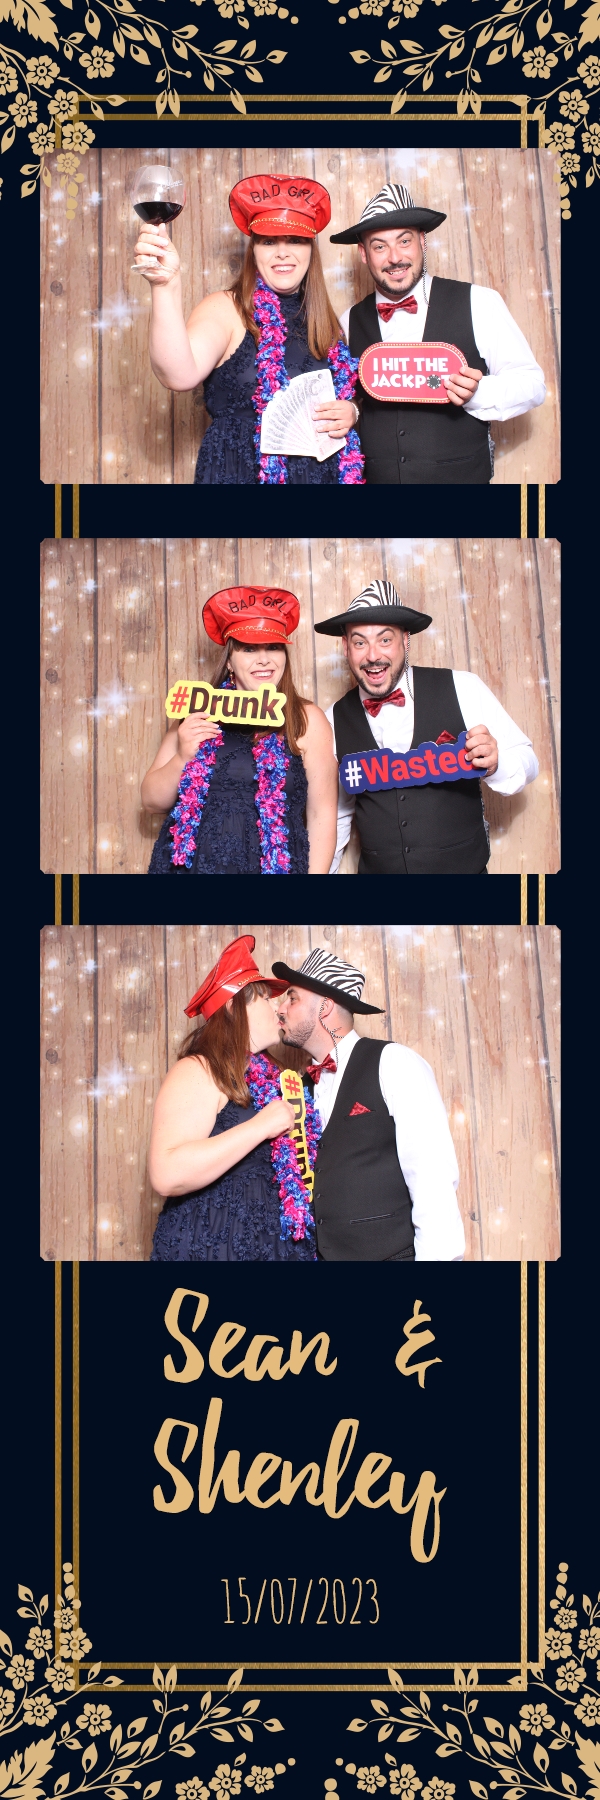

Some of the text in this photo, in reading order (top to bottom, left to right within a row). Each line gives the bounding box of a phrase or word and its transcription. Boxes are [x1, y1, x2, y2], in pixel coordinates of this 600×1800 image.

[250, 184, 281, 203] BAD
[373, 357, 448, 373] I HIT THE
[228, 594, 257, 614] BAD
[170, 685, 280, 721] #Drunk
